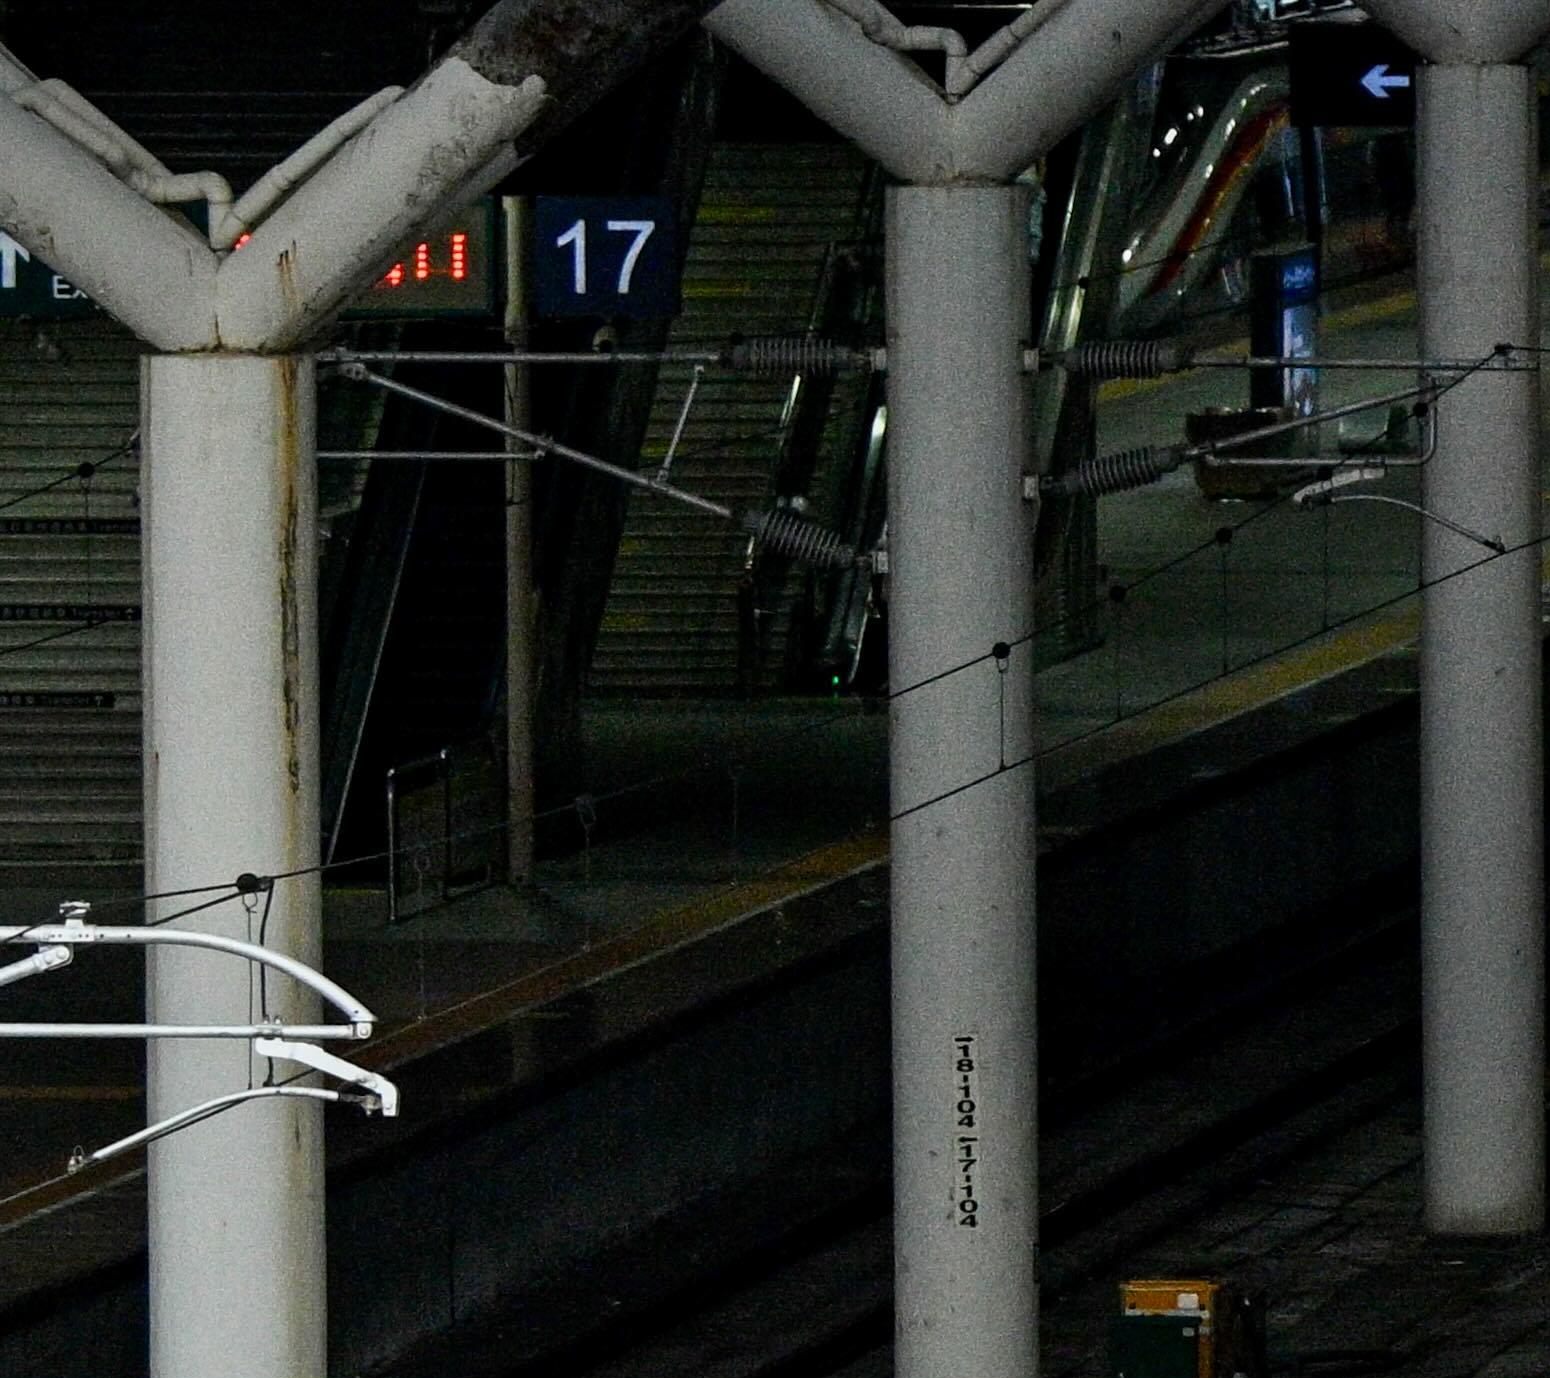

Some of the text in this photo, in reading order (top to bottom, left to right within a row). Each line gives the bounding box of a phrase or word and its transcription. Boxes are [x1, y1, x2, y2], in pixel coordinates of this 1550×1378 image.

[557, 220, 655, 294] 17
[956, 1044, 976, 1129] 18-104
[958, 1144, 978, 1229] 17-104
